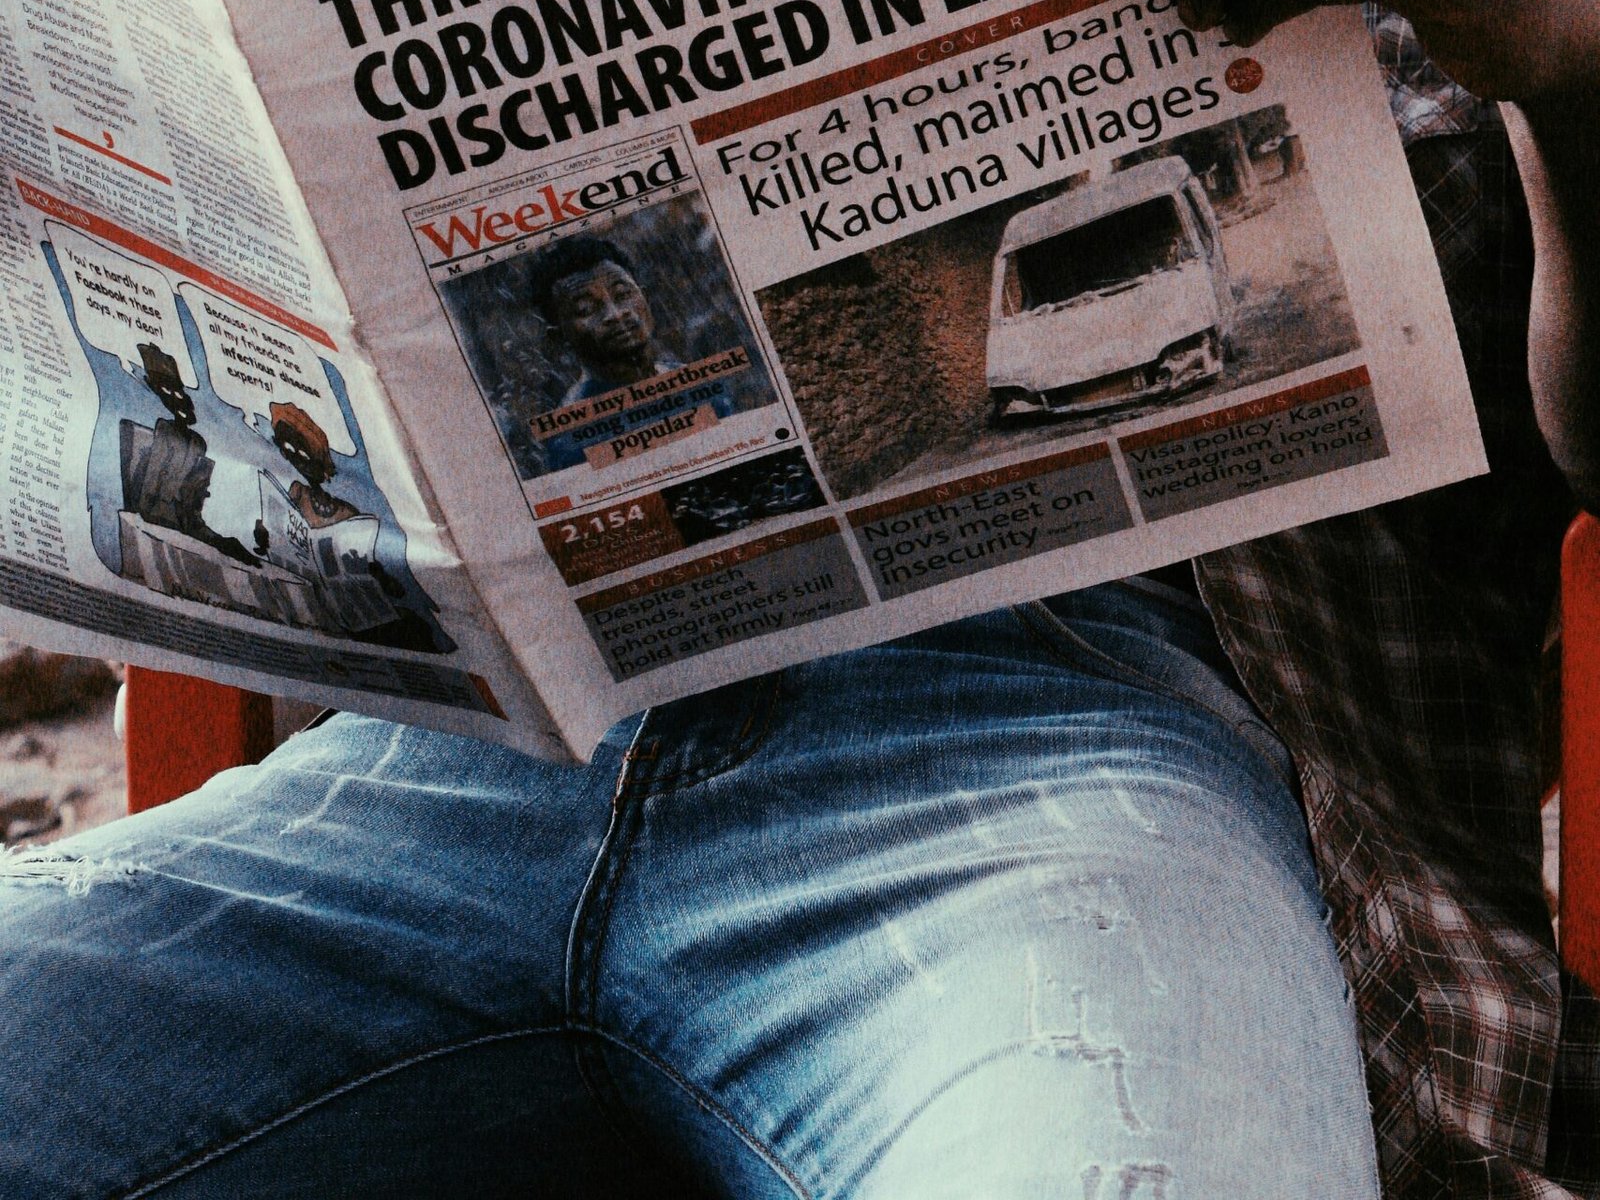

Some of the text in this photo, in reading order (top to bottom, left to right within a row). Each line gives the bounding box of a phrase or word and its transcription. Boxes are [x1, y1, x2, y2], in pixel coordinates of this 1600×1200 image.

[22, 2, 43, 22] Drug
[916, 15, 1024, 64] COVER
[377, 0, 831, 190] DISCHARGED
[716, 133, 797, 175] For
[818, 108, 850, 136] 4
[863, 49, 1030, 123] hours,
[738, 27, 1199, 216] killed, maimed in
[800, 75, 1220, 251] Kaduna villages
[414, 146, 688, 259] Weekend
[447, 185, 680, 276] MAGAZINE
[75, 270, 162, 320] Facebook these
[103, 265, 139, 295] hardly
[141, 285, 156, 298] on
[86, 295, 164, 339] days, my dear!
[203, 302, 295, 355] Because it seems
[209, 323, 302, 374] all my friends are
[220, 343, 321, 399] infectious disease
[227, 366, 273, 394] experts!
[593, 393, 626, 416] my
[629, 351, 749, 401] heartbreak
[572, 381, 724, 443] song made me
[1130, 395, 1358, 464] Visa policy: Kano
[1201, 398, 1286, 427] NEWS
[936, 469, 1020, 498] NEWS
[1136, 439, 1272, 482] instagram
[1143, 426, 1374, 499] wedding on hold
[560, 504, 645, 543] 2,154
[863, 481, 1041, 542] North-East
[873, 529, 950, 566] govs
[959, 500, 1045, 538] meet
[1051, 489, 1096, 511] on
[628, 536, 787, 594] BUSINESS
[880, 526, 1039, 586] insecurity
[593, 567, 744, 626] Despite tech
[601, 580, 759, 641] trends, street
[611, 573, 835, 661] photographers still
[616, 644, 673, 675] hold
[681, 634, 713, 652] art
[713, 610, 785, 640] firmly
